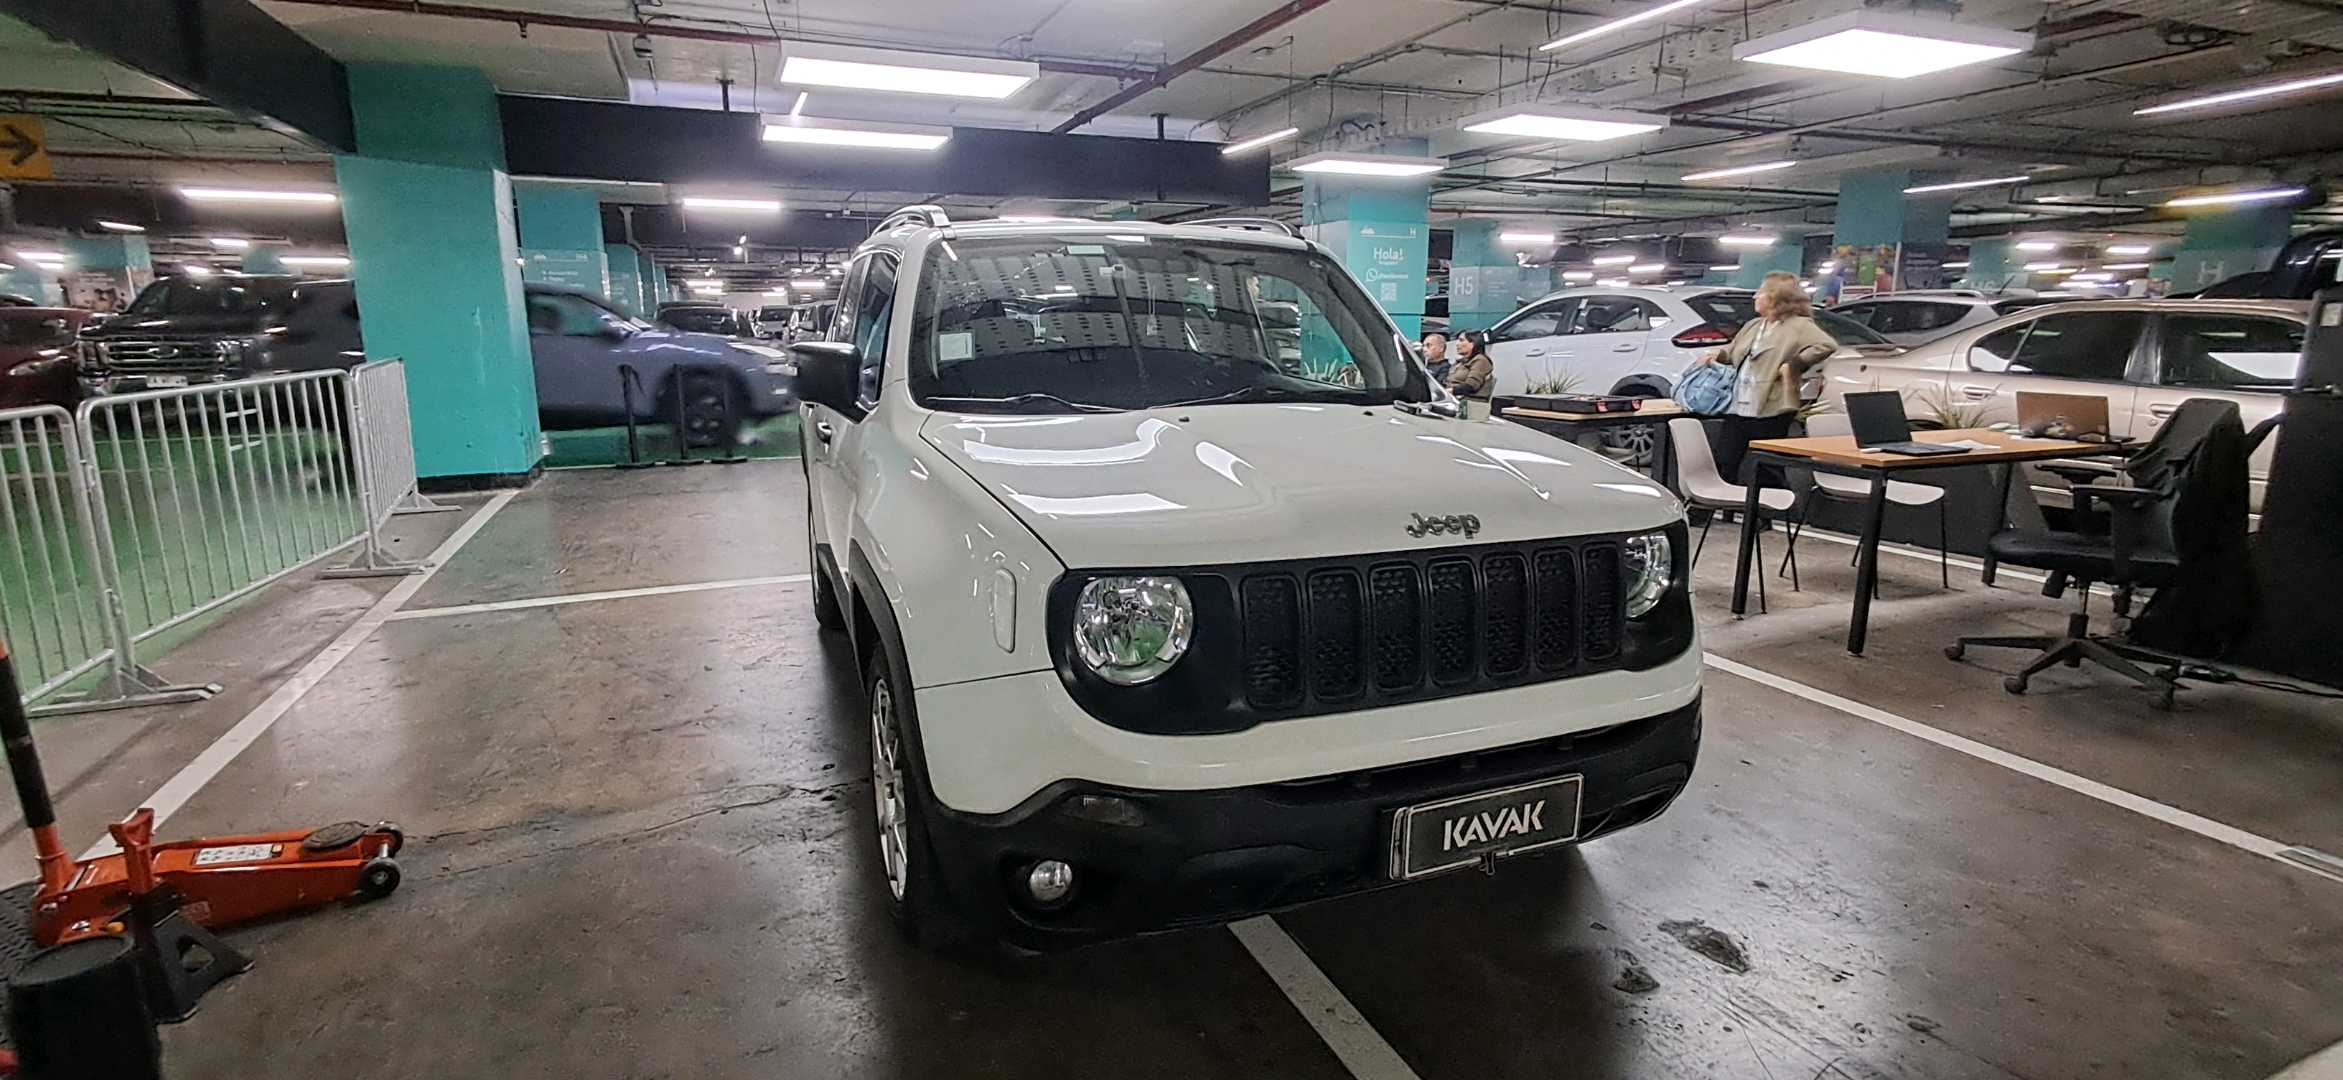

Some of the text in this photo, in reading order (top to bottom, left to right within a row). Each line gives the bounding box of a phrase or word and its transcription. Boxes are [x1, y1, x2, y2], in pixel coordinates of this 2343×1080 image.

[1409, 227, 1417, 236] H
[1373, 247, 1404, 261] Hola!
[1455, 276, 1474, 296] H5
[1406, 512, 1481, 540] Jeep
[1443, 800, 1546, 851] KAVAK
